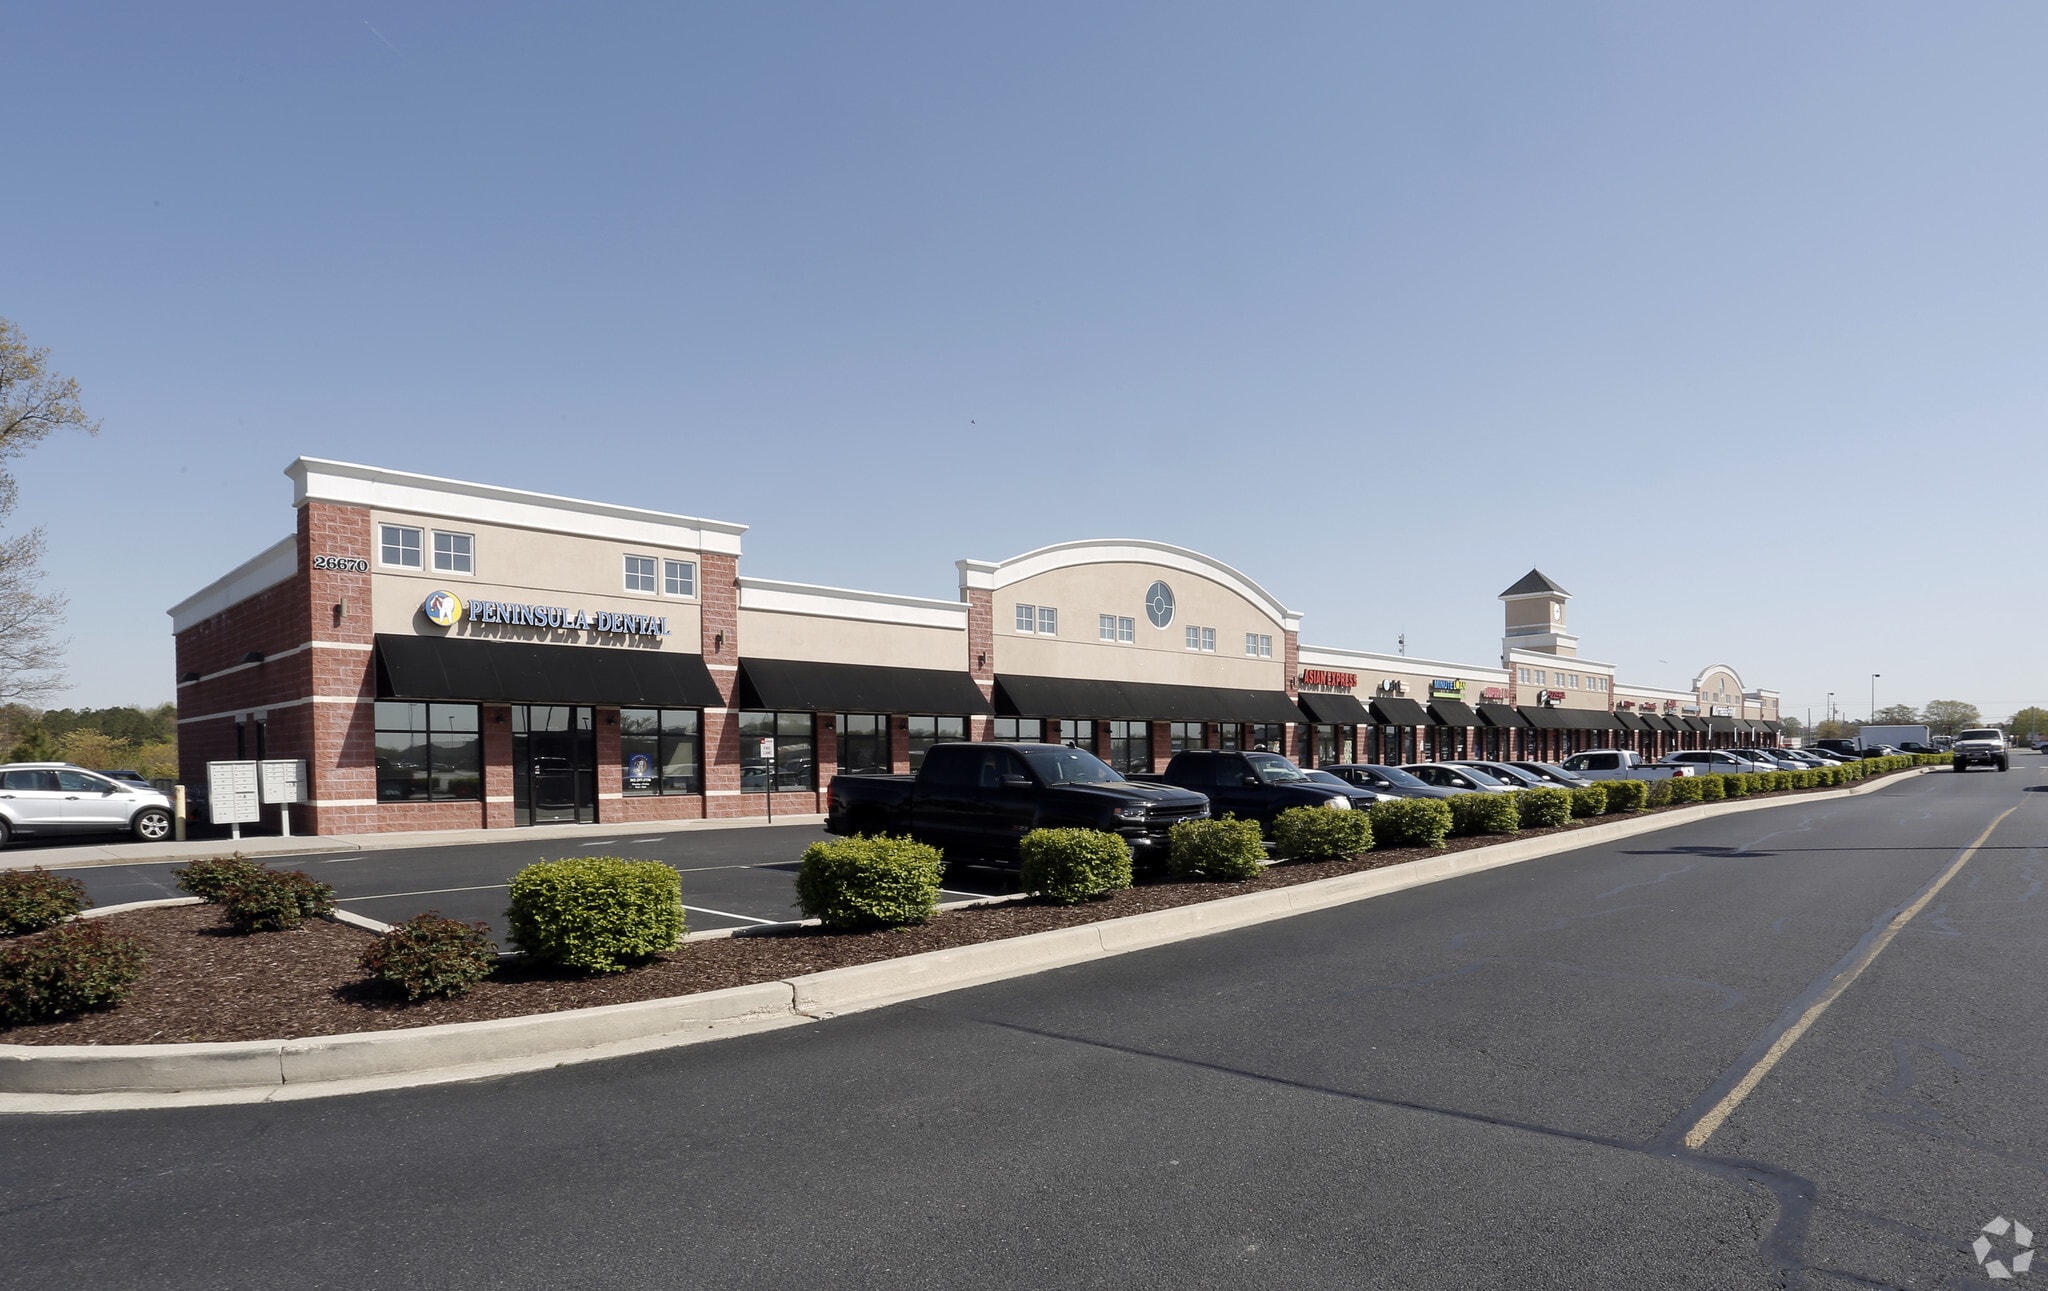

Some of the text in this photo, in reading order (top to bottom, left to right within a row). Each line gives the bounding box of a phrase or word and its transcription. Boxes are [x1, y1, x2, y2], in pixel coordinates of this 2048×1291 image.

[314, 555, 369, 573] 26670
[467, 599, 672, 636] PENINSULA DENTAL
[1303, 669, 1357, 687] ASIAN EXPRESS
[1433, 679, 1454, 690] MINUTE
